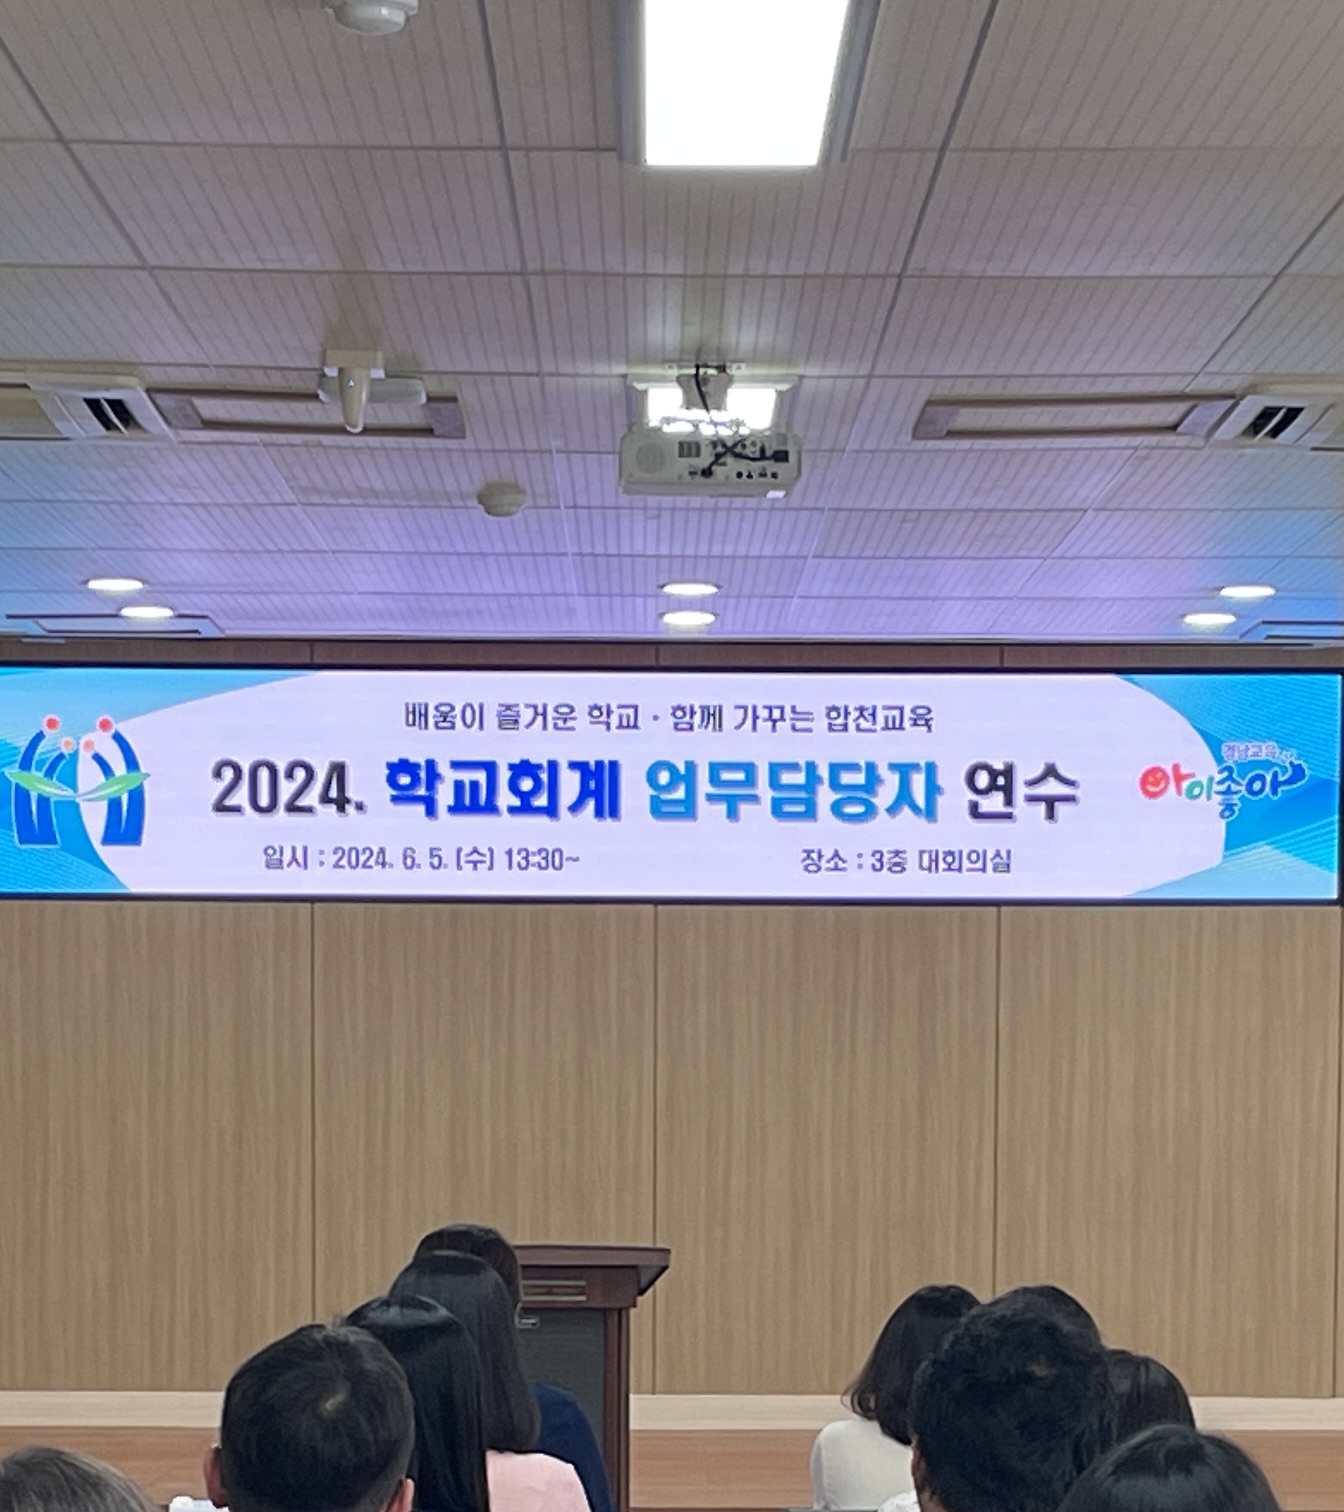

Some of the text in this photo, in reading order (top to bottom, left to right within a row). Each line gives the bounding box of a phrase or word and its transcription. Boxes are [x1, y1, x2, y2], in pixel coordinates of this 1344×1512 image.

[404, 702, 484, 732] 배움이
[496, 702, 577, 732] 즐거운
[587, 702, 640, 732] 학교
[670, 703, 723, 733] 함께
[733, 704, 815, 733] 가꾸는
[825, 703, 934, 734] 합천교육
[212, 757, 1080, 822] 2024. 학교회계 업무담당자 연수
[1140, 762, 1307, 819] 아이좋아
[263, 845, 308, 871] 일시
[332, 846, 394, 870] 2024.
[402, 847, 423, 870] 6.
[429, 847, 448, 870] 5.
[800, 849, 847, 874] 장소
[871, 849, 908, 874] 3층
[918, 848, 1013, 874] 대회의실
